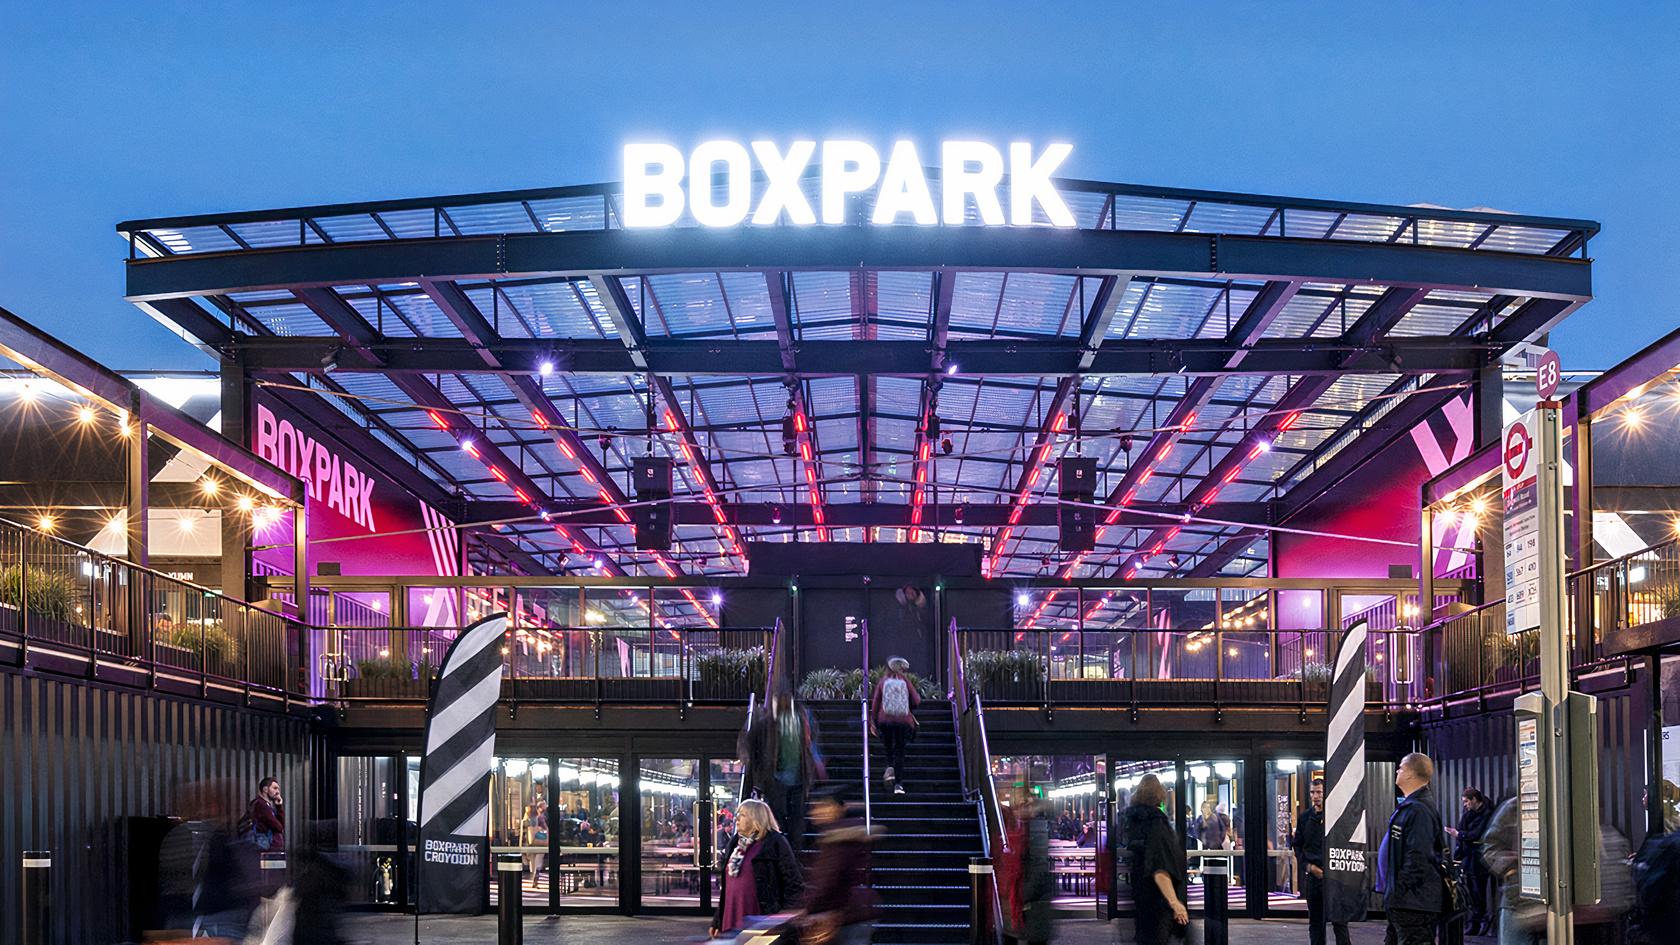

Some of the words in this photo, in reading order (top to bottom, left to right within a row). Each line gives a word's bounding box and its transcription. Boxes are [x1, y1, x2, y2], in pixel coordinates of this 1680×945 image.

[622, 140, 1077, 228] BOXPARK
[1539, 360, 1557, 391] E8
[257, 402, 376, 533] BOXPARK
[424, 851, 479, 865] CROYDON
[425, 839, 478, 854] BOXPARK
[1329, 847, 1365, 861] BOXPARK
